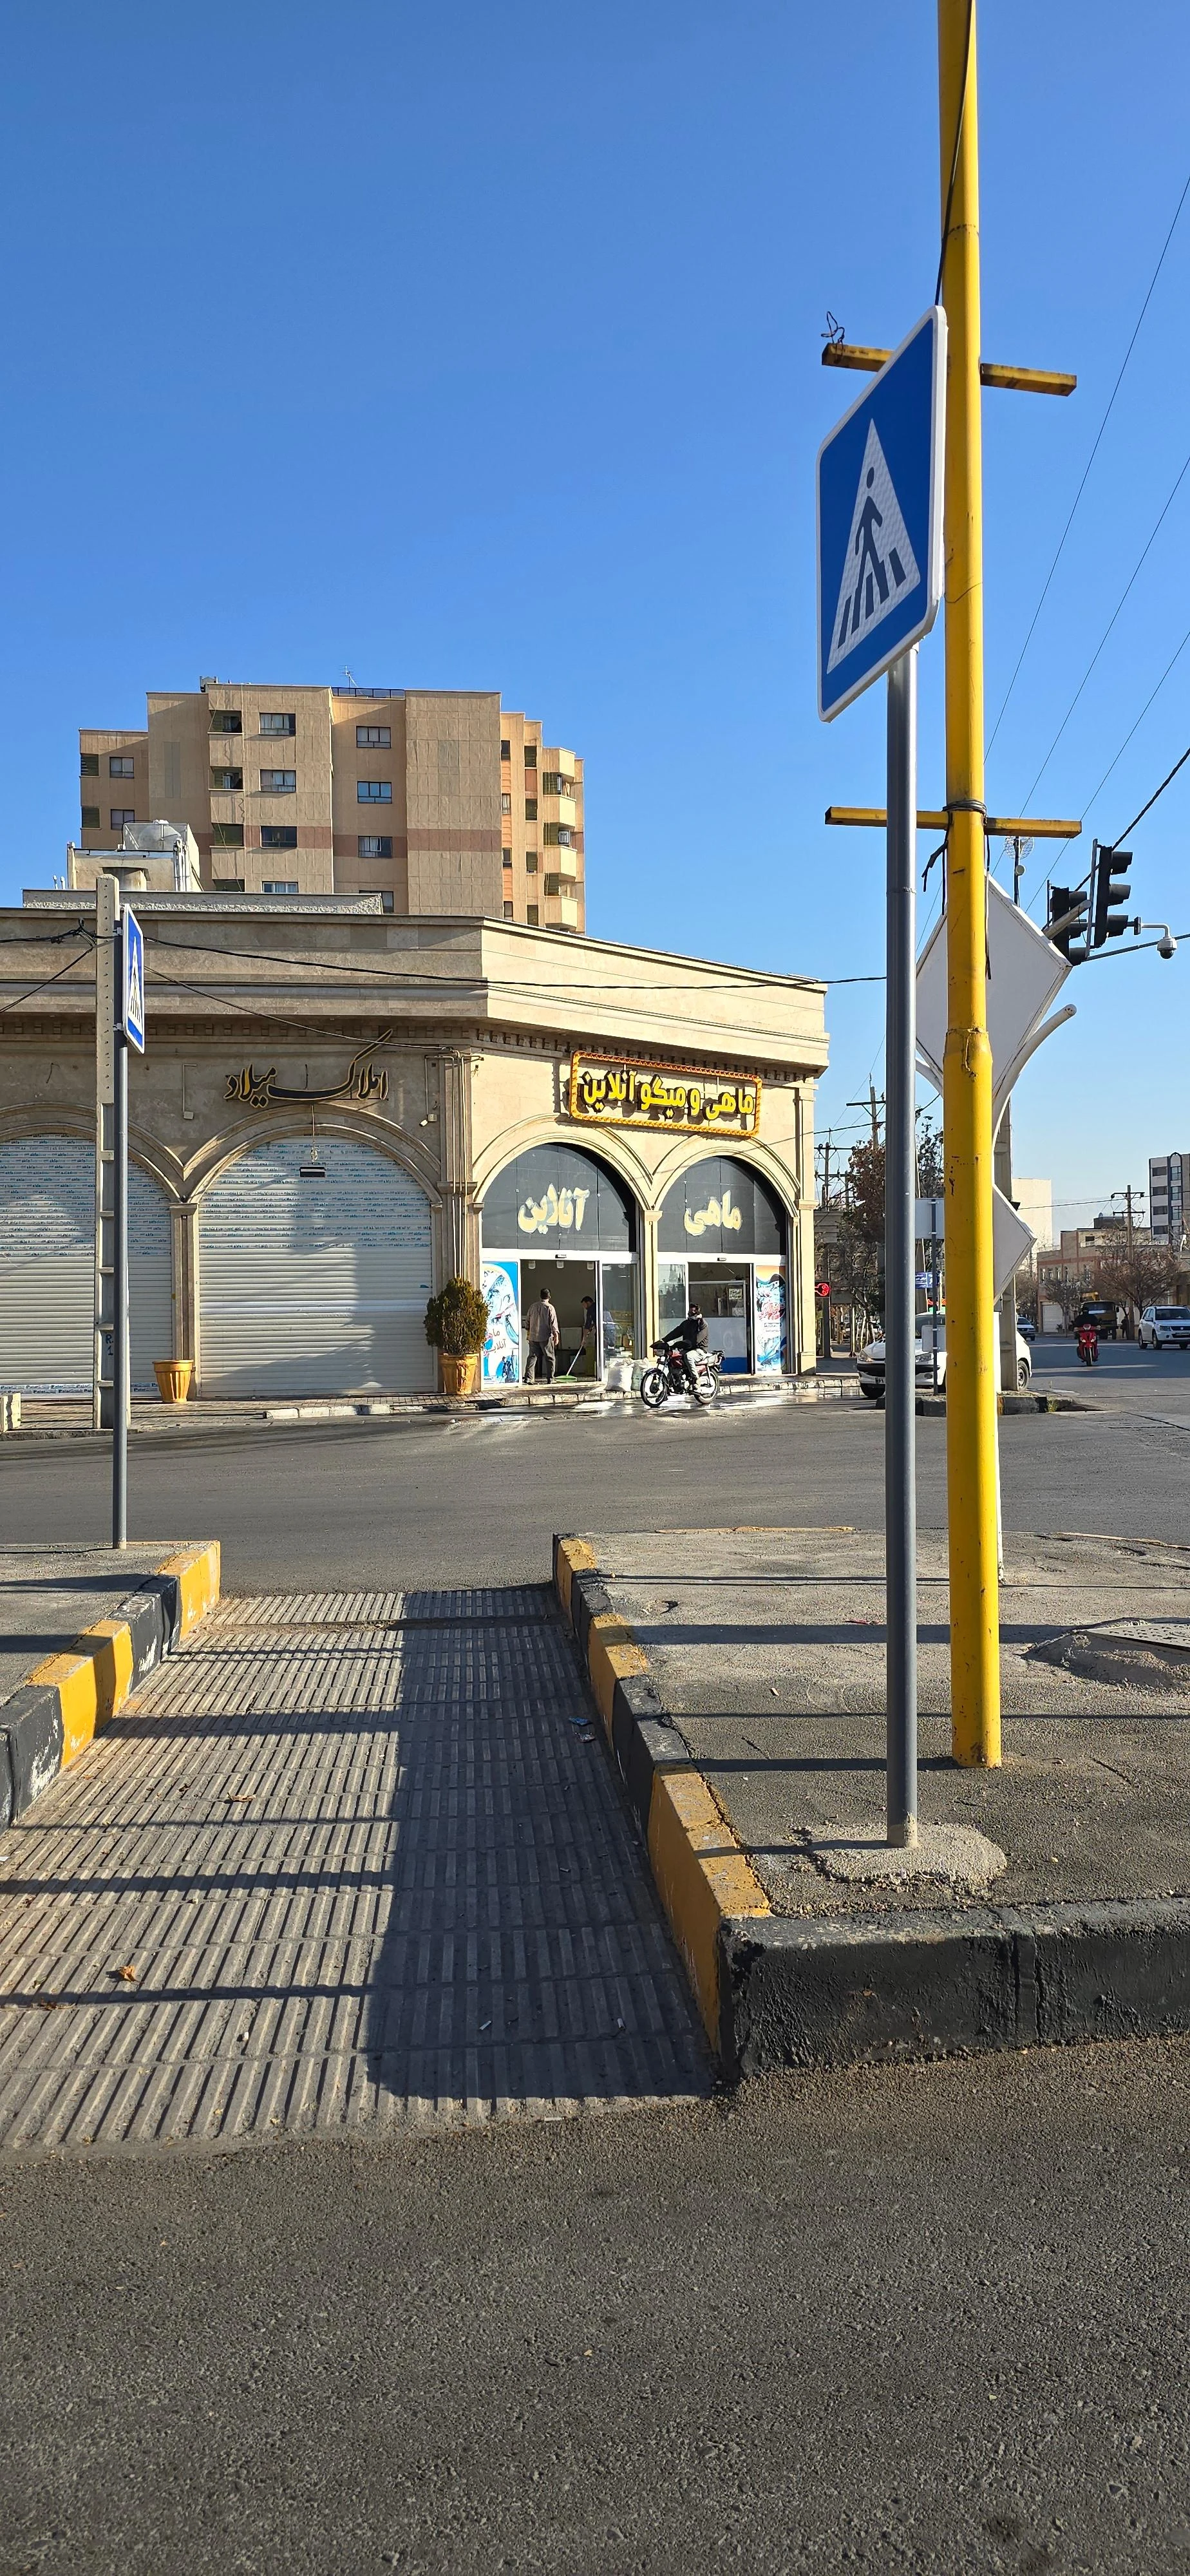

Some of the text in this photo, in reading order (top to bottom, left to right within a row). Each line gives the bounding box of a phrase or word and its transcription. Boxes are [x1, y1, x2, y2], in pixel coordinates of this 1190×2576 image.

[223, 1028, 393, 1108] املاک میلاد
[581, 1070, 754, 1121] ماهی و میگو آنلاین
[518, 1183, 590, 1234] آنلاین
[684, 1190, 742, 1236] ماهی
